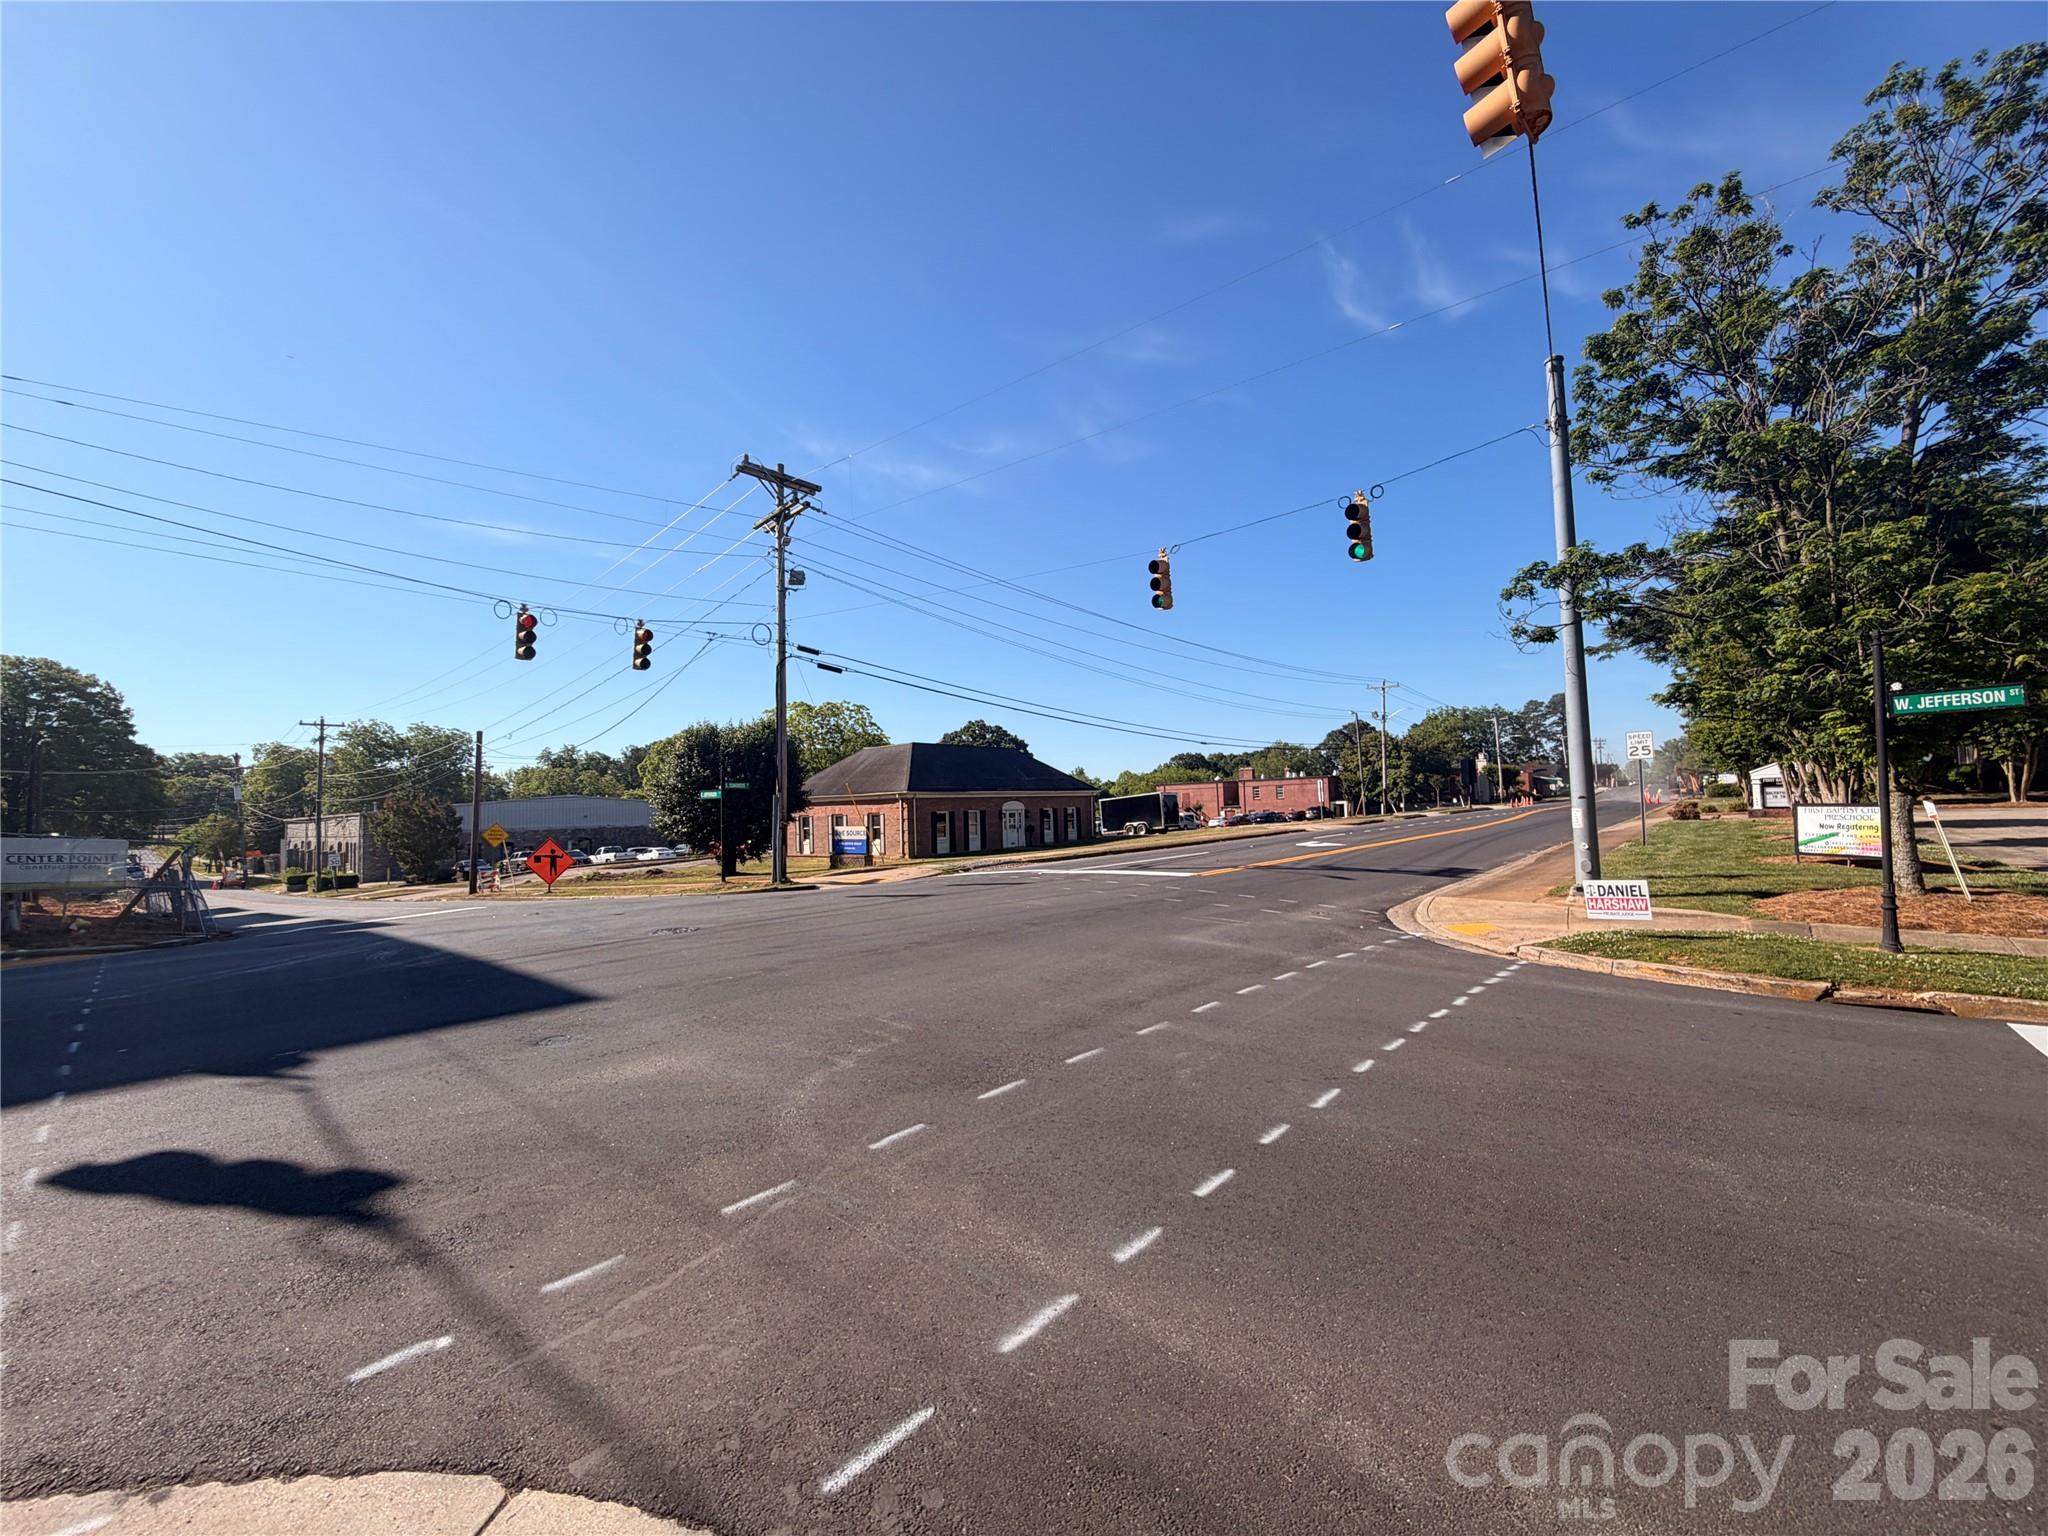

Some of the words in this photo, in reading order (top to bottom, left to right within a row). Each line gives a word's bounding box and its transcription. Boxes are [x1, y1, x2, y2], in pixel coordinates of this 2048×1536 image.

[1894, 698, 1913, 711] W.
[1917, 690, 2006, 709] JEFFERSON
[2009, 688, 2019, 696] ST
[1629, 745, 1651, 757] 25
[1836, 823, 1879, 833] Registering
[6, 855, 65, 863] CENTER
[1597, 885, 1646, 897] DANIEL
[1588, 898, 1647, 910] HARSHAW
